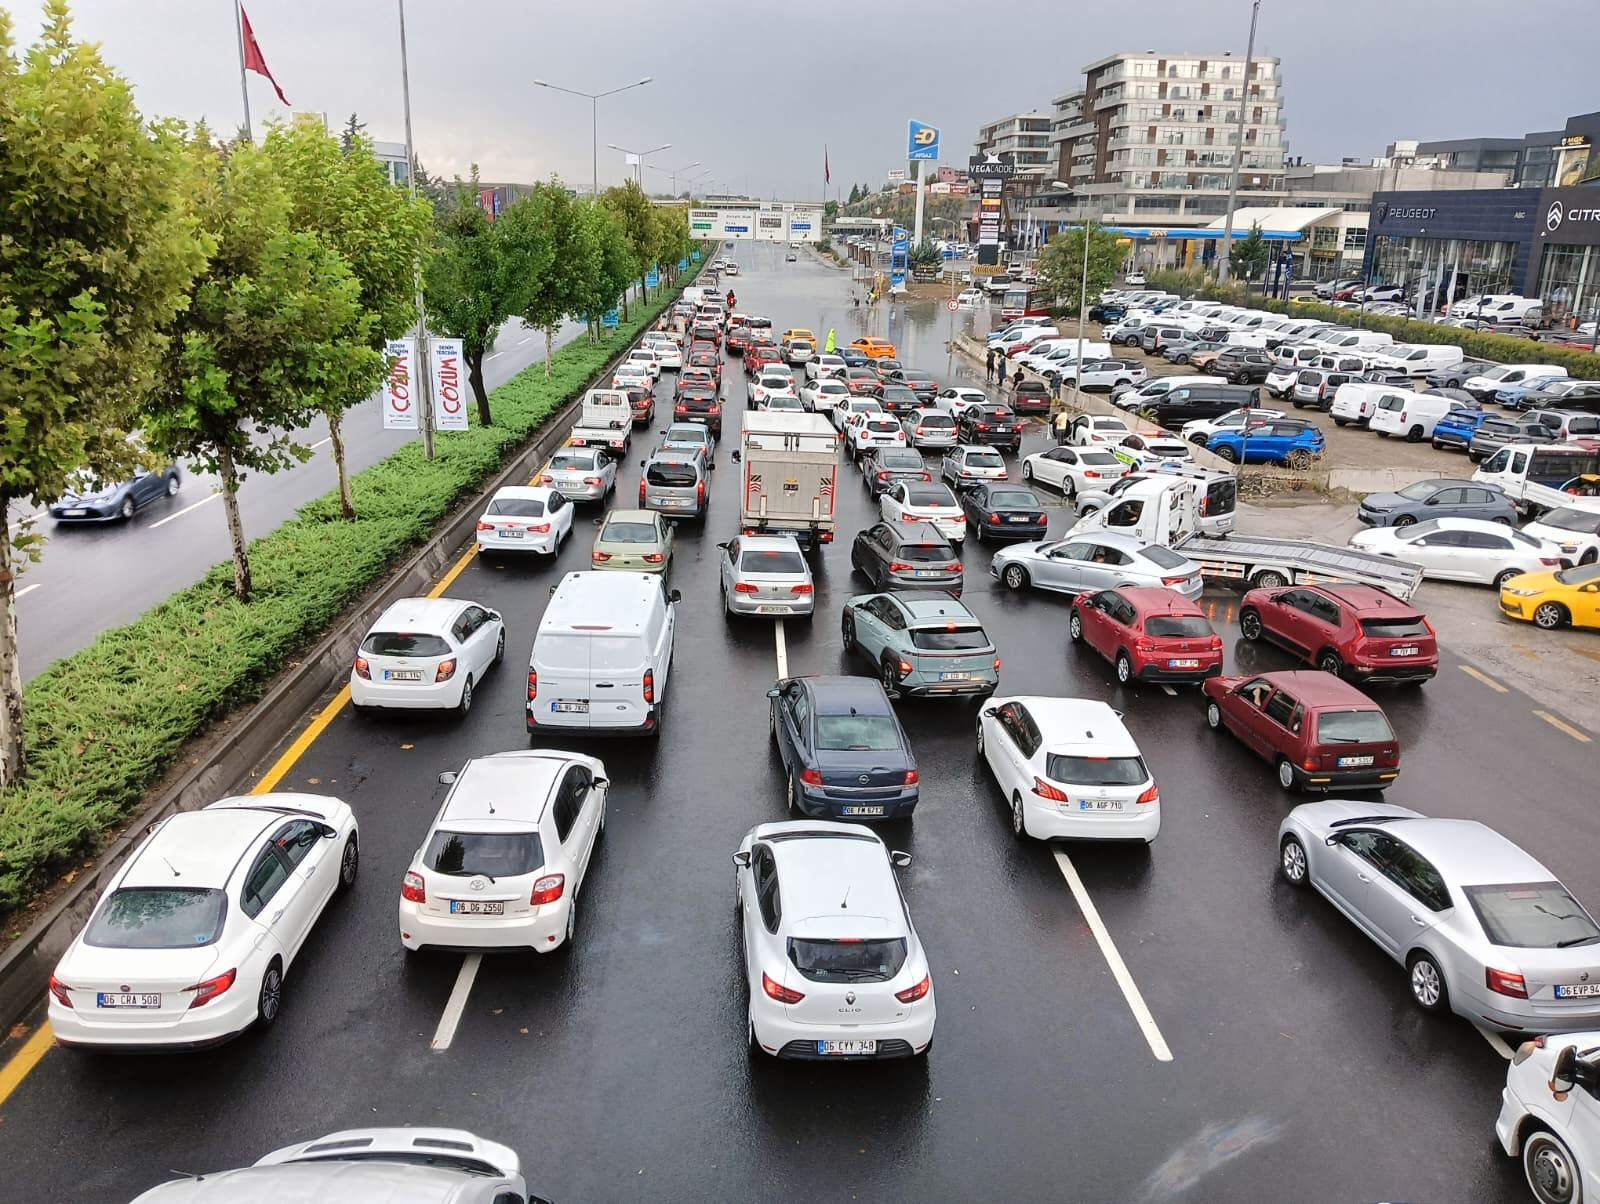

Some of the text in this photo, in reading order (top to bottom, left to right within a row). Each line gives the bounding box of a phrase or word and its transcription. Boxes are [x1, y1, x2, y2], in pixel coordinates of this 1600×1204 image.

[1389, 208, 1437, 219] PEUGEOT
[438, 357, 461, 414] ÇÖZÜM
[456, 901, 466, 911] 06
[483, 903, 502, 912] 2550
[1561, 987, 1571, 995] 06
[1573, 986, 1588, 995] EVP
[104, 995, 158, 1005] 06 CRA 508
[824, 1041, 874, 1051] 06 CYY 348
